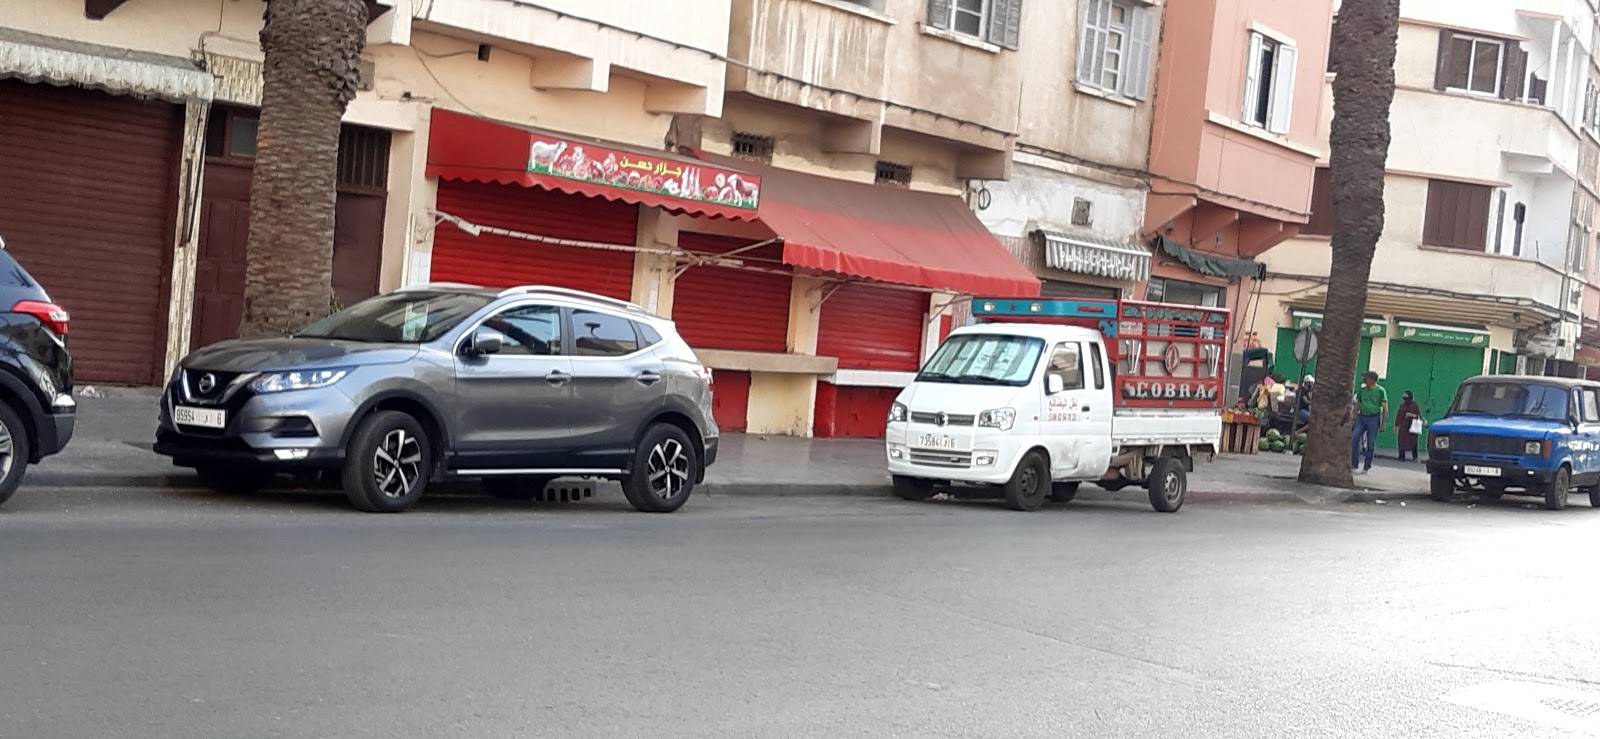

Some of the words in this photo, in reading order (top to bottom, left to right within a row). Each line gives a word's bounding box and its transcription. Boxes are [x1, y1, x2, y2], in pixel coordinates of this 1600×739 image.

[620, 156, 653, 171] حسن
[653, 162, 682, 178] جزار
[1136, 381, 1207, 399] COBRA
